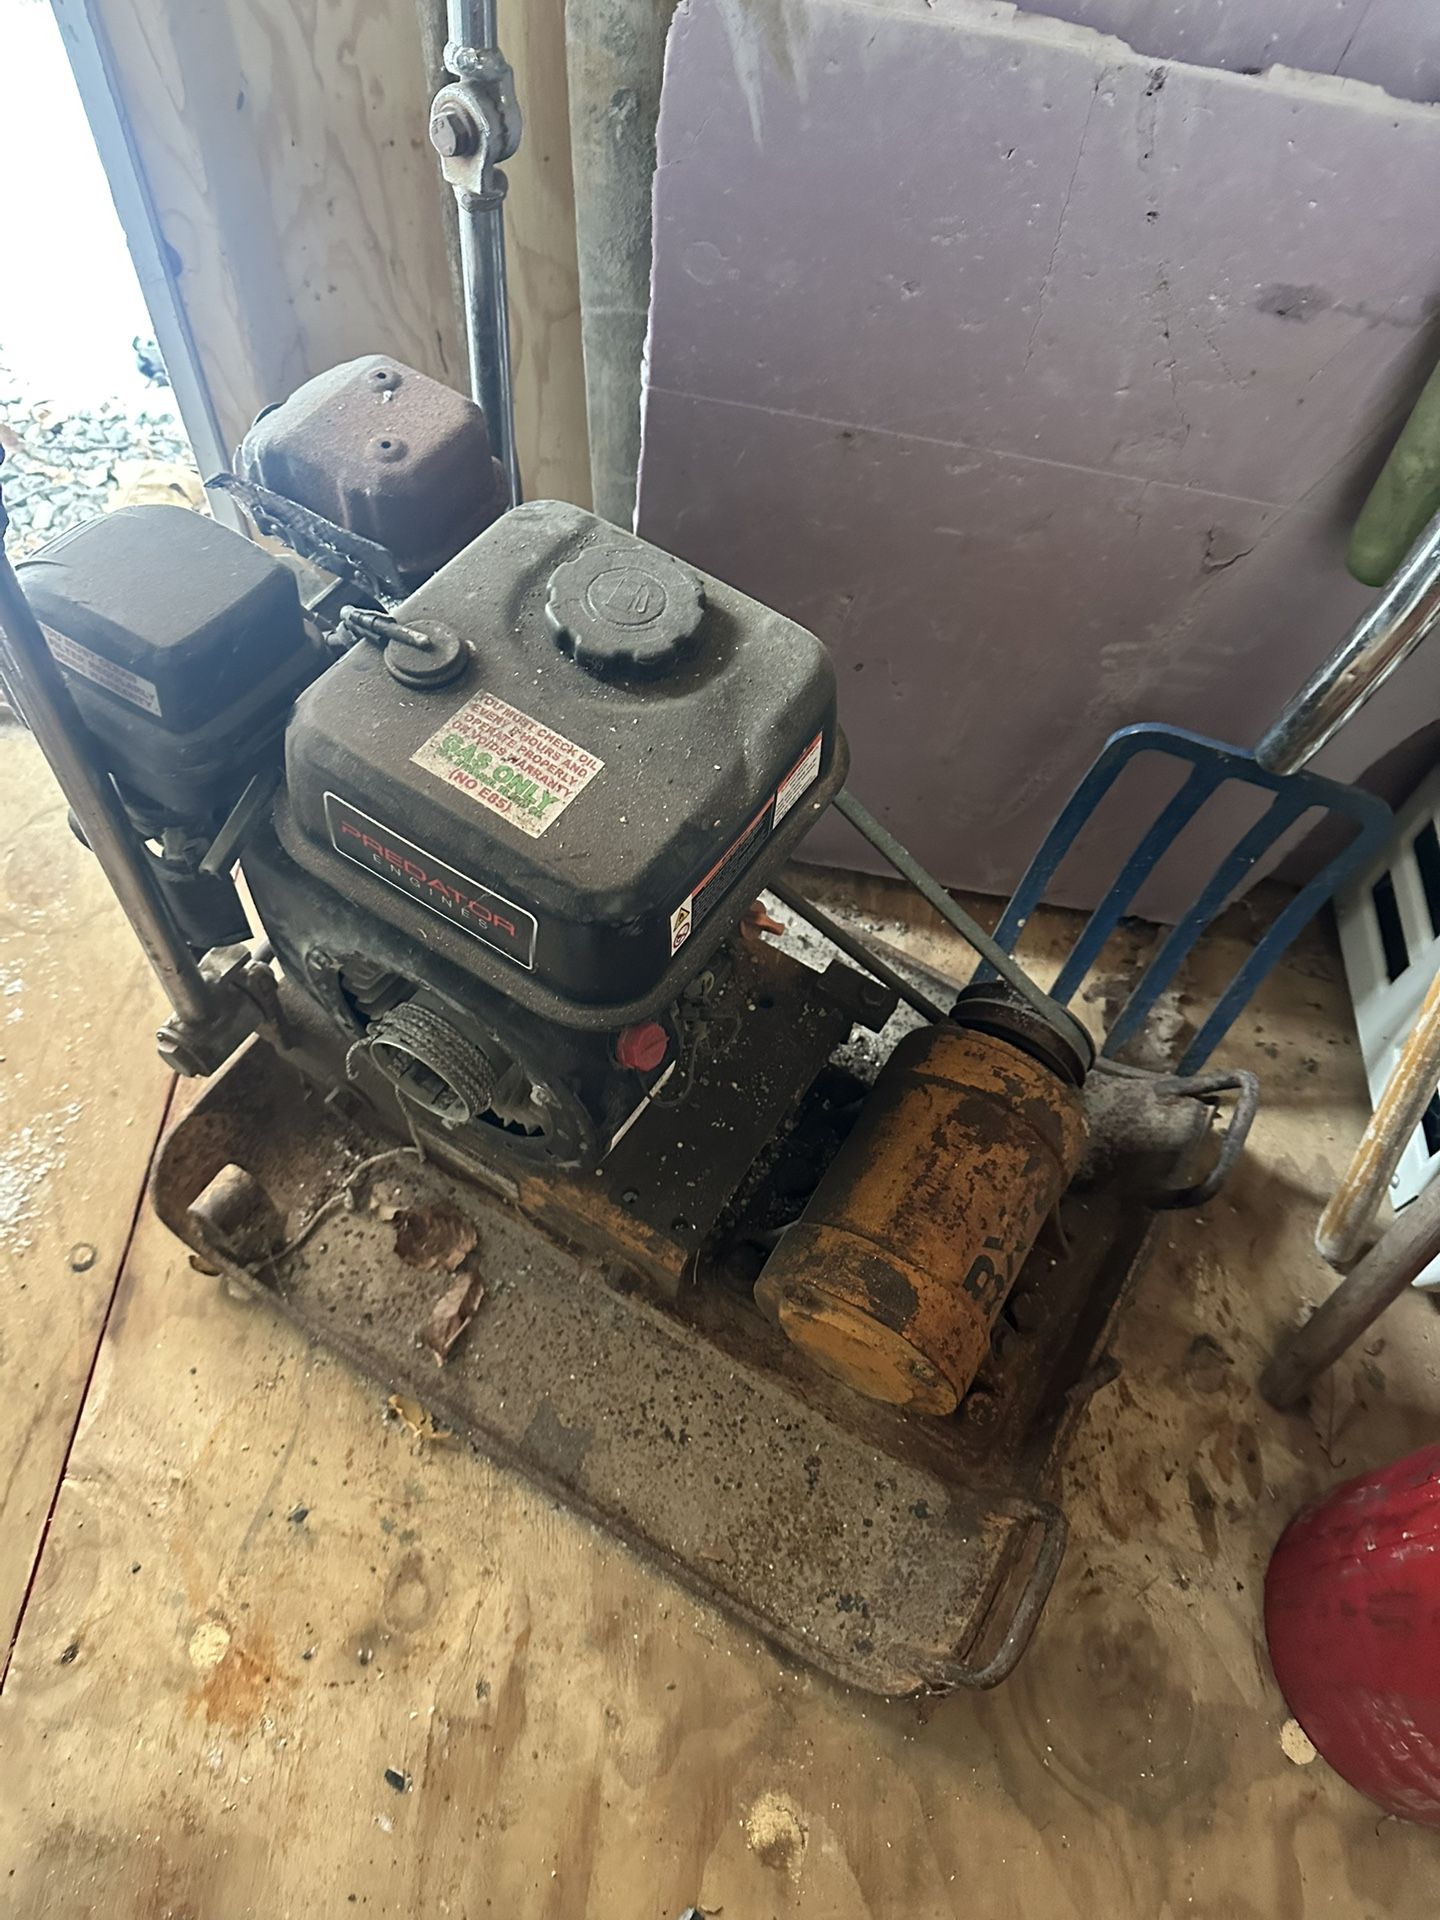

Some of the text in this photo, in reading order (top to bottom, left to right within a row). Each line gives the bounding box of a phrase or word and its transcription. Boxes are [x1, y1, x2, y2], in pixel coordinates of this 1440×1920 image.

[441, 734, 493, 769] GAS
[493, 765, 561, 812] ONLY
[464, 712, 578, 787] OPERATE PROPERLY
[470, 730, 507, 757] VOIDS
[508, 753, 573, 798] WARRANTY
[471, 703, 511, 729] EVERY
[520, 731, 563, 760] HOURS
[563, 758, 588, 778] AND
[504, 708, 537, 733] MUST
[538, 728, 579, 757] CHECK
[579, 754, 597, 771] OIL
[448, 768, 478, 790] (NO
[478, 787, 512, 812] E85)
[341, 822, 515, 936] PREDATOR
[372, 853, 488, 930] ENGINES
